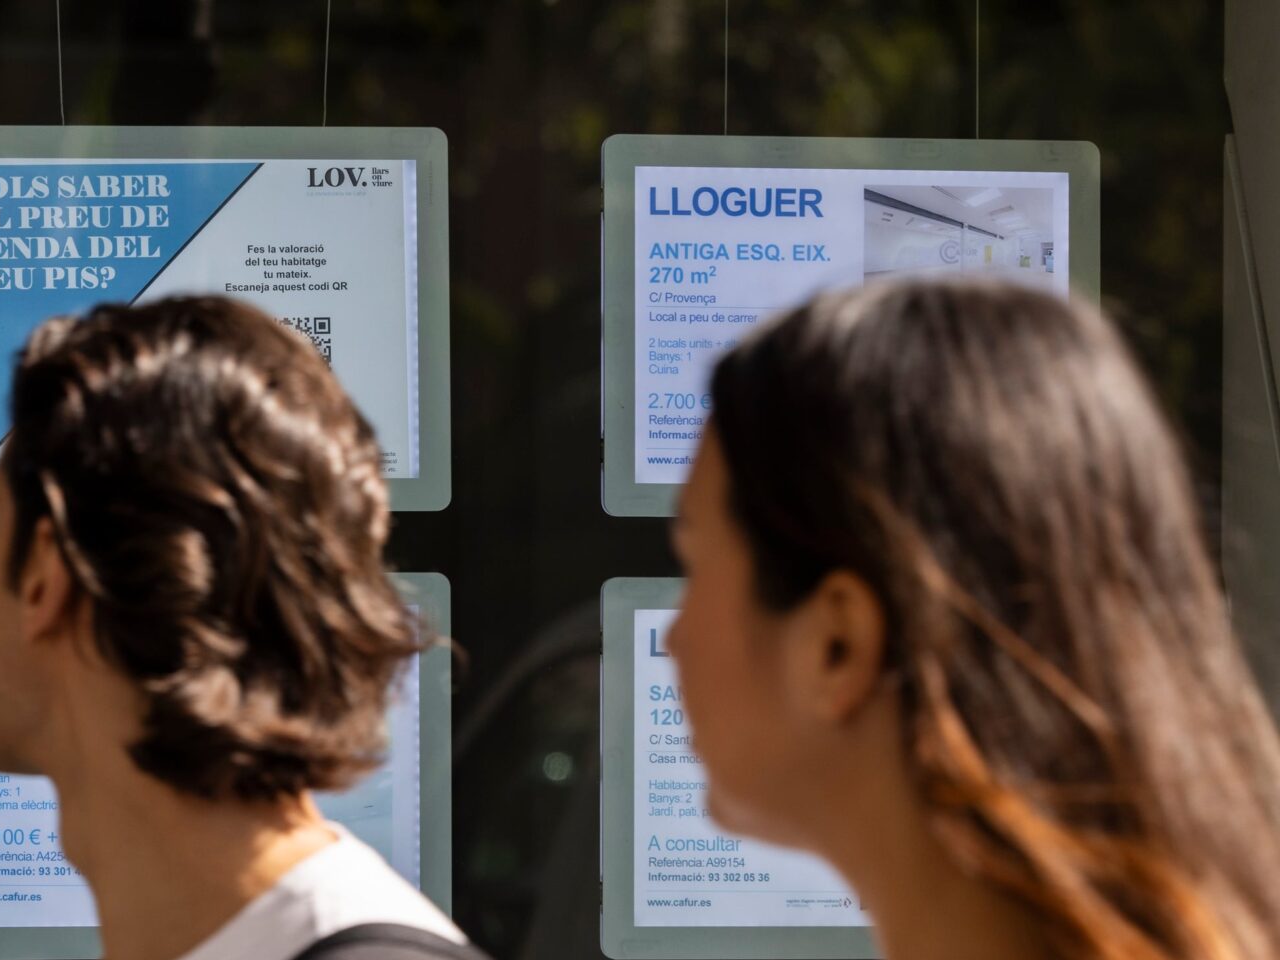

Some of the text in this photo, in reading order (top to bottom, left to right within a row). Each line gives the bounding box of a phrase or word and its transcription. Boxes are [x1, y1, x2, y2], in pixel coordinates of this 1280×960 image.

[58, 175, 170, 197] SABER
[650, 187, 824, 217] LLOGUER
[18, 205, 113, 228] PREU
[120, 205, 169, 227] DE
[88, 236, 160, 258] DEL
[248, 244, 324, 253] Fes la valoració
[649, 243, 831, 261] ANTIGA ESQ. EIX.
[245, 258, 260, 266] del
[281, 257, 326, 267] habitatge
[42, 266, 116, 289] PIS?
[276, 270, 311, 278] mateix.
[649, 267, 683, 283] 270
[225, 282, 348, 293] Escaneja aquest codi QR
[649, 292, 716, 306] C/ Provença
[649, 312, 757, 324] Local a peu de carrer
[649, 364, 678, 374] Cuina
[648, 393, 695, 409] 2.700
[650, 709, 683, 725] 120
[649, 754, 676, 764] Casa
[29, 829, 40, 845] €
[648, 835, 741, 851] A consultar
[649, 857, 745, 868] Referència: A99154
[39, 867, 50, 876] 93
[54, 867, 70, 876] 301
[649, 873, 770, 882] Informació: 93 302 05 36
[647, 898, 711, 908] www.cafur.es
